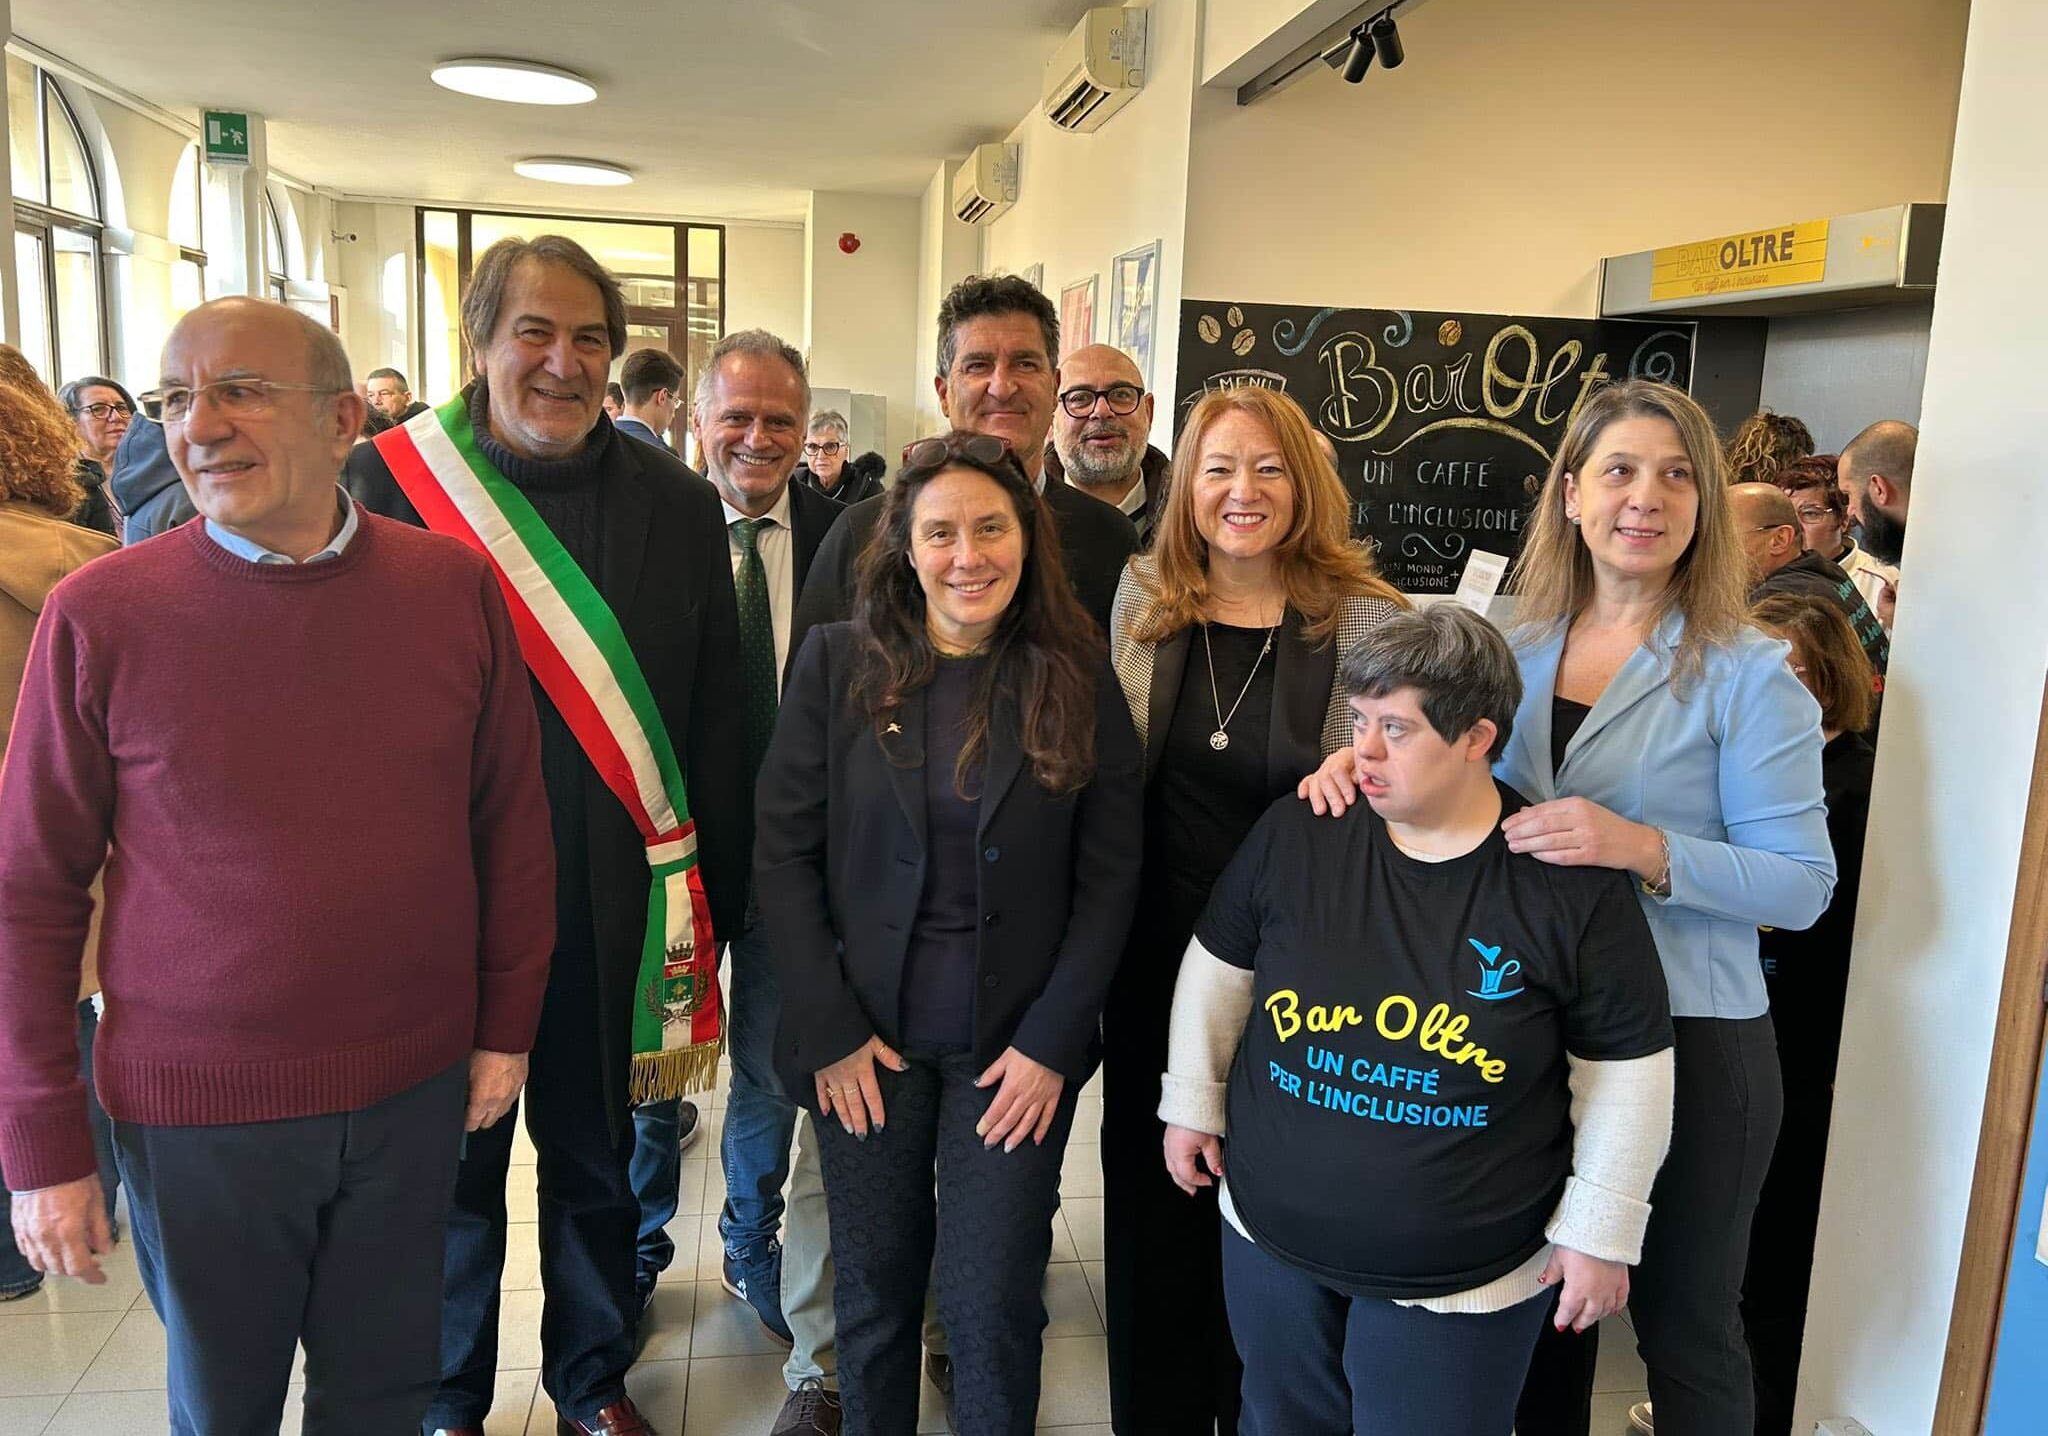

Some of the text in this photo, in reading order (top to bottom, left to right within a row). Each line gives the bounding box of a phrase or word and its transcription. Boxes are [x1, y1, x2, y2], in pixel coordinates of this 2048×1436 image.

[1363, 456, 1495, 488] UN CAFFÉ
[1389, 502, 1520, 532] L'INCLUSIONE
[1407, 563, 1444, 575] MONDO
[1265, 989, 1507, 1083] Bar Oltre
[1307, 1045, 1440, 1095] UN CAFFÉ
[1269, 1060, 1489, 1127] PER L'INCLUSIONE
